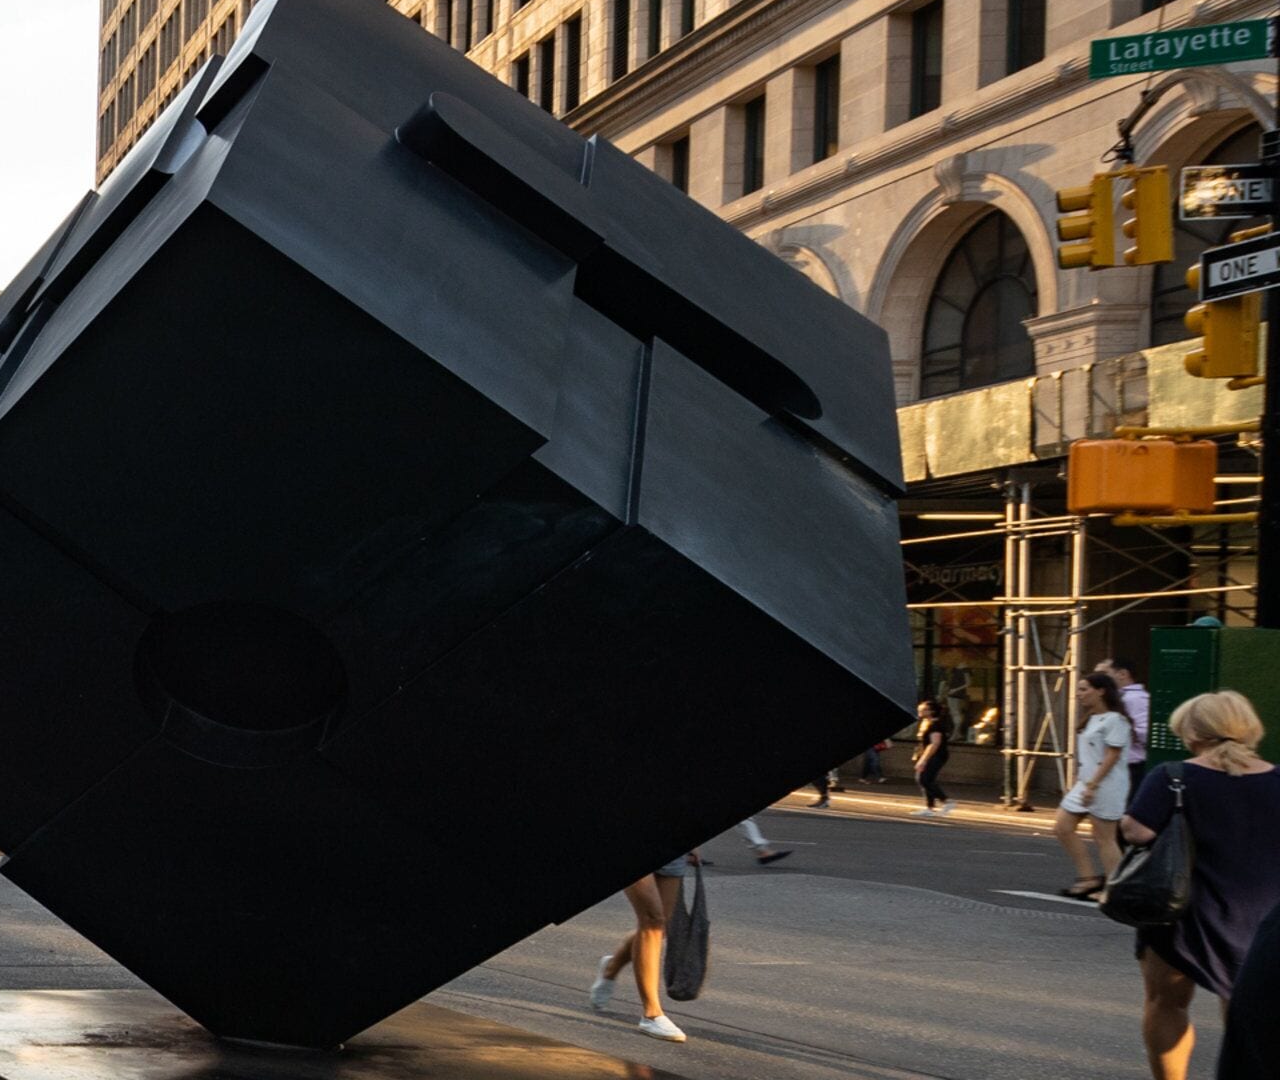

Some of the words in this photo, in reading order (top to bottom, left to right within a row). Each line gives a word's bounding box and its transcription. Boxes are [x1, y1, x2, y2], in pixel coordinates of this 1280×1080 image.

[1109, 26, 1251, 59] Lafayette
[1109, 59, 1154, 74] Street
[1219, 255, 1259, 282] ONE
[919, 563, 1003, 586] Pharmacy
